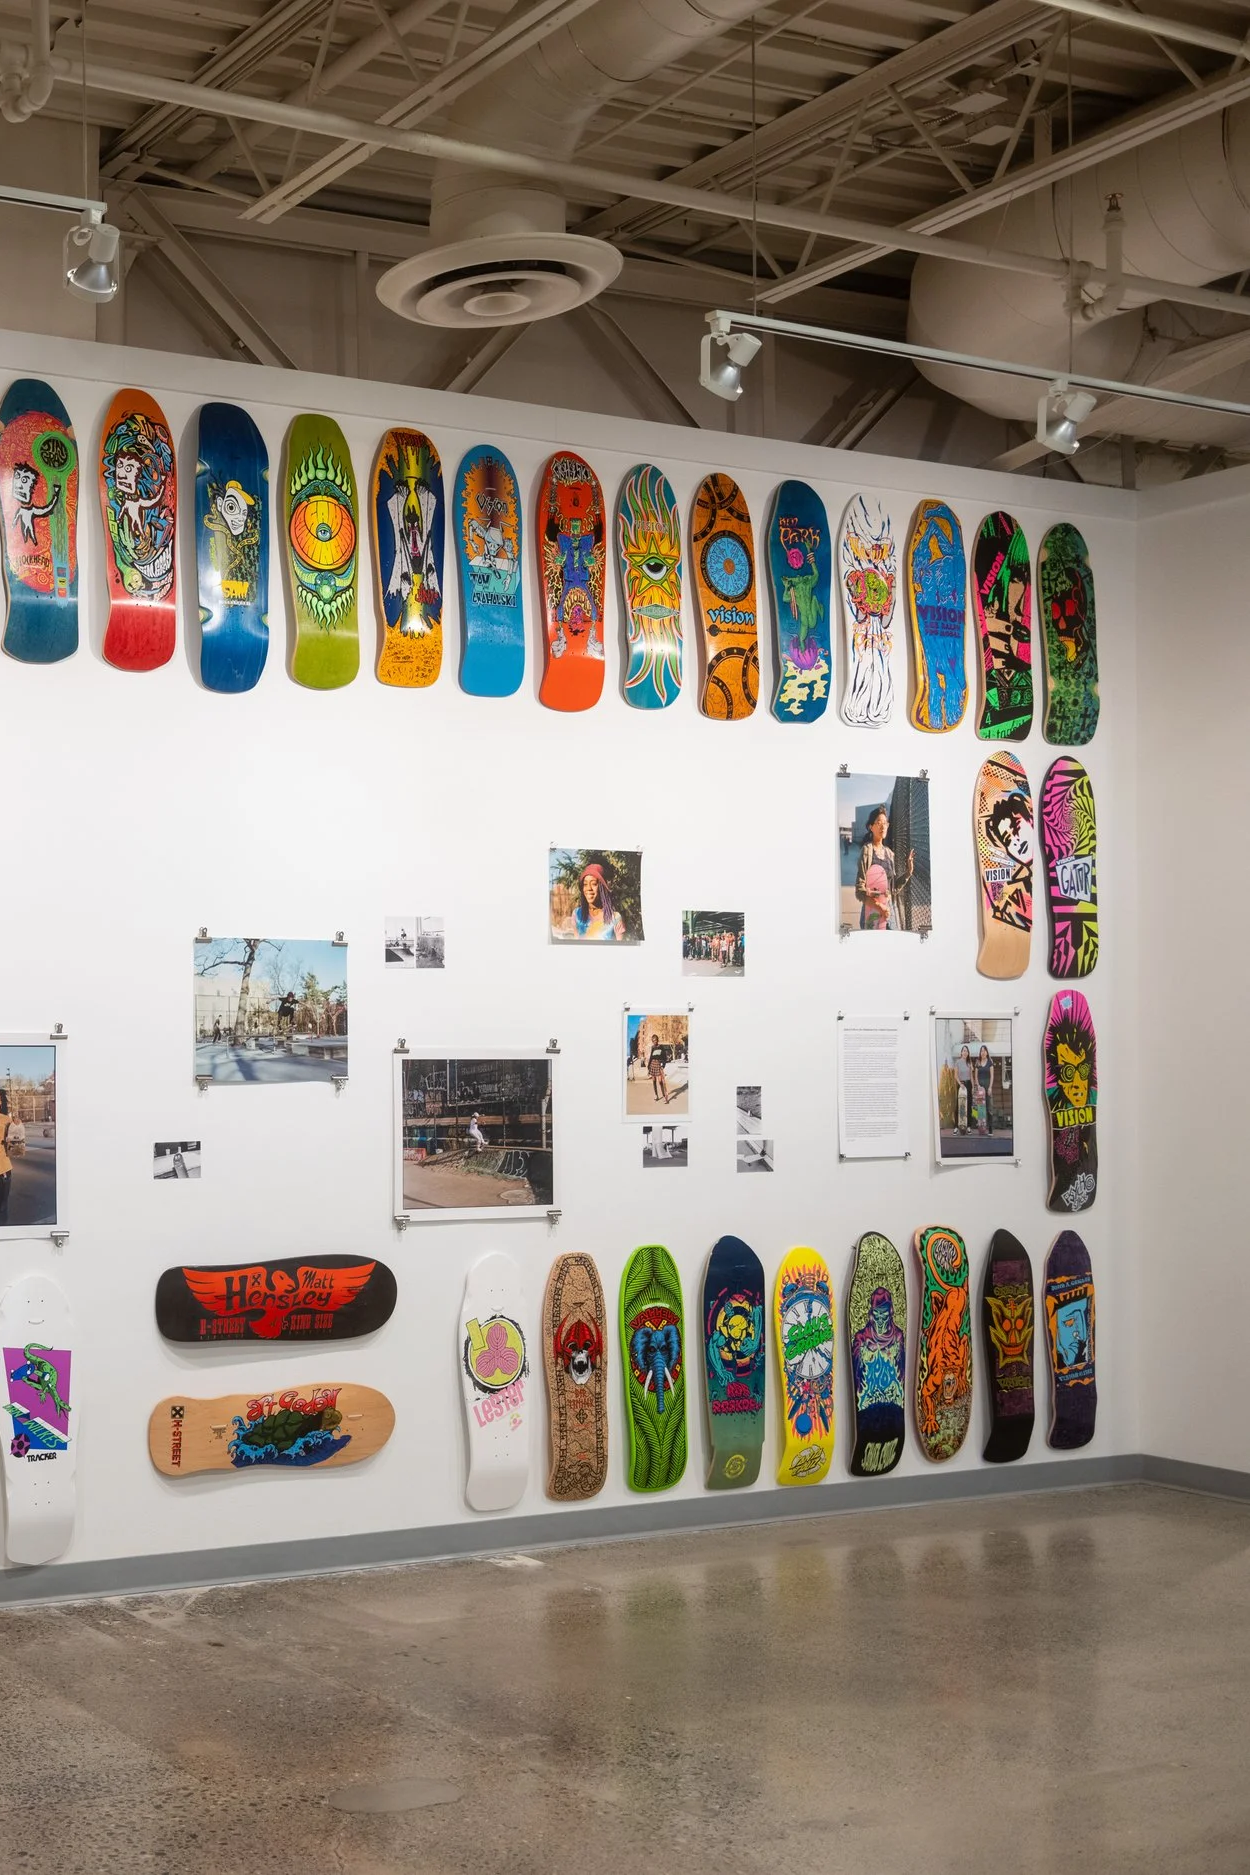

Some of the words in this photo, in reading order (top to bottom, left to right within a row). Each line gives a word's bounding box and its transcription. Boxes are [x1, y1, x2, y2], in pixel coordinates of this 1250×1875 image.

[980, 551, 1006, 595] VISION
[221, 579, 249, 599] SAM
[707, 605, 756, 626] vision
[916, 605, 965, 624] VISION
[985, 867, 1011, 881] VISION
[1056, 1107, 1093, 1127] VISION
[302, 1270, 334, 1289] Matt
[631, 1307, 680, 1329] VALLELY
[788, 1313, 829, 1341] CLAUS
[171, 1419, 183, 1468] H-STREET
[26, 1452, 57, 1462] TRACKER
